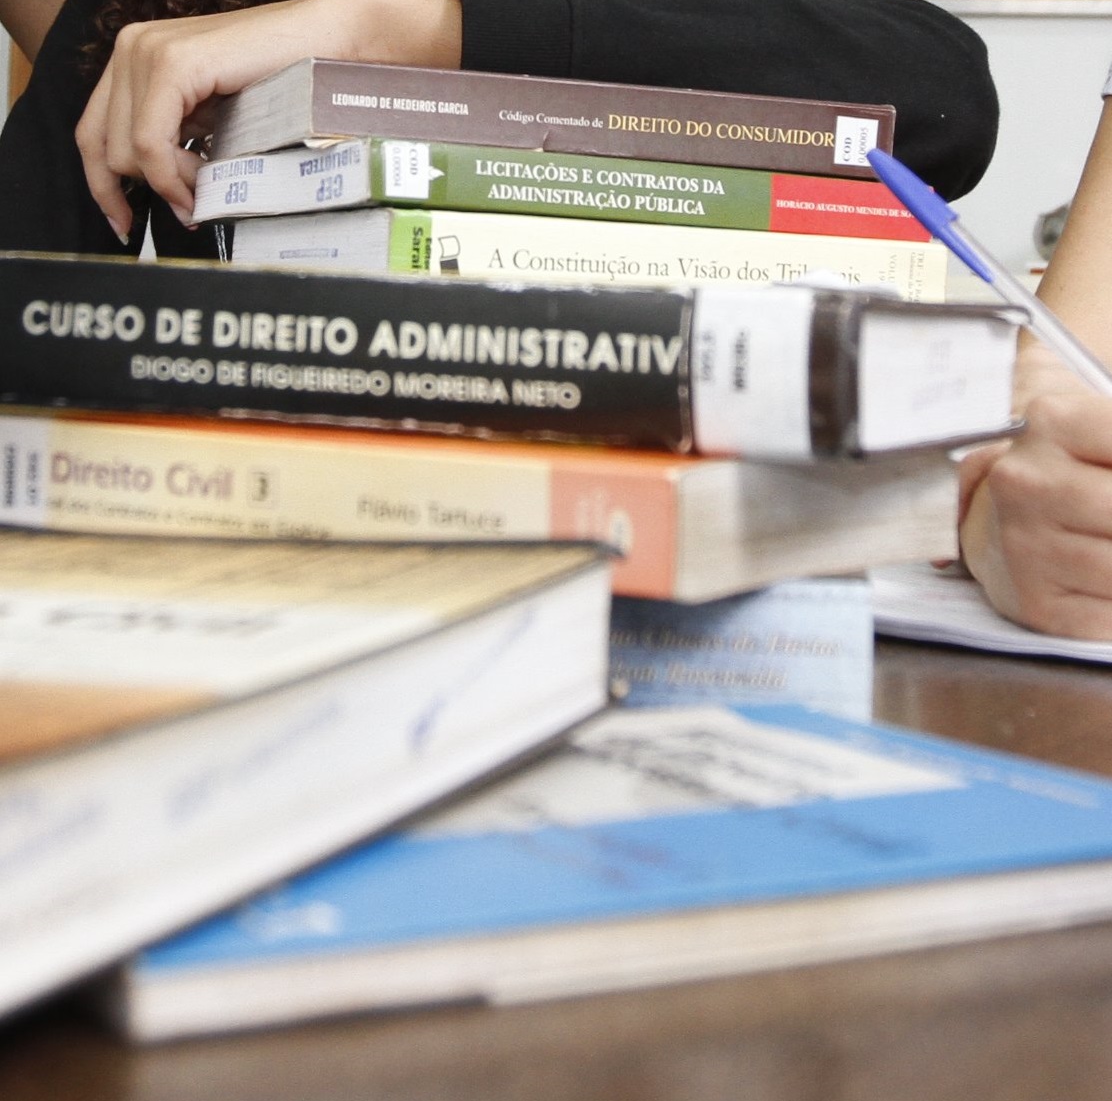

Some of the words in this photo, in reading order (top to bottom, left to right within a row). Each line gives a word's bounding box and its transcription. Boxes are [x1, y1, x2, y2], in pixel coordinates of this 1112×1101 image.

[332, 93, 377, 109] LEONARDO
[379, 97, 392, 110] DE
[393, 98, 437, 113] MEDEIROS
[438, 102, 469, 116] GARCIA
[499, 110, 535, 125] Código
[536, 113, 590, 127] Comentado
[592, 119, 604, 128] de
[608, 114, 682, 135] DIREITO
[686, 121, 712, 137] DO
[716, 123, 835, 148] CONSUMIDOR
[300, 143, 361, 177] BIBLIOTECA
[410, 148, 418, 176] COD
[843, 137, 852, 162] COD
[212, 158, 264, 181] BIBLIOTECA
[475, 159, 578, 183] LICITAÇÕES
[582, 168, 593, 184] E
[596, 170, 698, 193] CONTRATOS
[702, 178, 725, 195] DA
[225, 180, 248, 205] CEP
[316, 174, 343, 202] CEP
[487, 183, 631, 211] ADMINISTRAÇÃO
[634, 192, 706, 216] PÚBLICA
[816, 203, 855, 214] AUGUSTO
[856, 206, 887, 217] MENDES
[888, 209, 899, 217] DE
[413, 227, 423, 270] Sarai
[488, 249, 504, 269] A
[512, 249, 640, 281] Constituição
[648, 260, 669, 276] na
[678, 257, 731, 280] Visão
[737, 261, 769, 282] dos
[22, 300, 146, 342] CURSO
[155, 307, 203, 346] DE
[212, 311, 358, 355] DIREITO
[368, 320, 685, 375] ADMINISTRATIV
[130, 355, 214, 384] DIOGO
[216, 360, 248, 386] DE
[251, 363, 391, 397] FIGUEIREDO
[394, 371, 511, 405] MOREIRA
[512, 378, 582, 409] NETO
[51, 452, 154, 493] Direito
[165, 463, 235, 500] Civil
